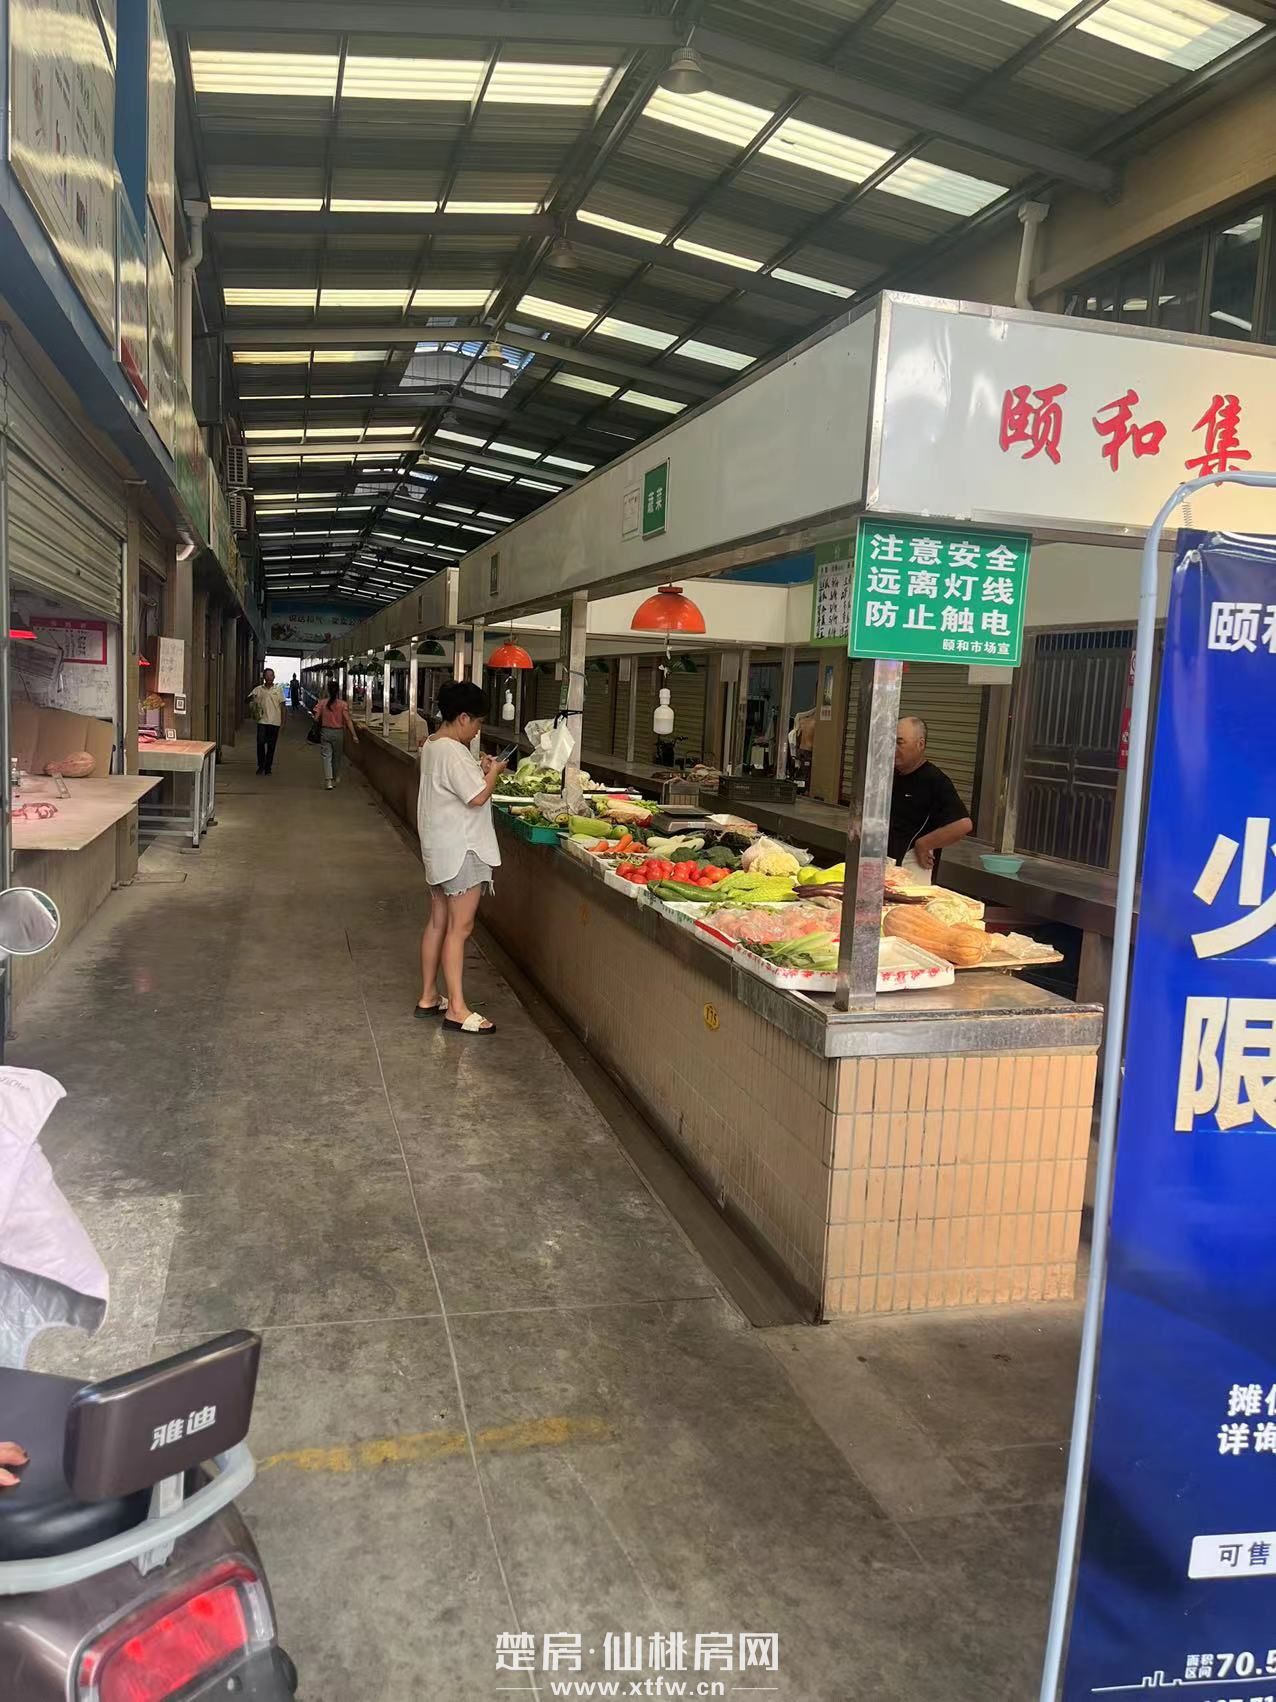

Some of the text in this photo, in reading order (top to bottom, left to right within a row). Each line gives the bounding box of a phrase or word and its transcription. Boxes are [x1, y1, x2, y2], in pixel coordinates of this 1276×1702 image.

[1000, 383, 1252, 487] 颐和集
[870, 533, 1018, 572] 注意安全
[866, 566, 1014, 605] 远离灯线
[865, 601, 1011, 637] 防止触电
[1208, 602, 1276, 654] 颐
[942, 639, 1010, 655] 颐和市场宣
[1174, 997, 1276, 1132] 限
[150, 1405, 216, 1451] 雅迪
[1219, 1541, 1272, 1567] 可售
